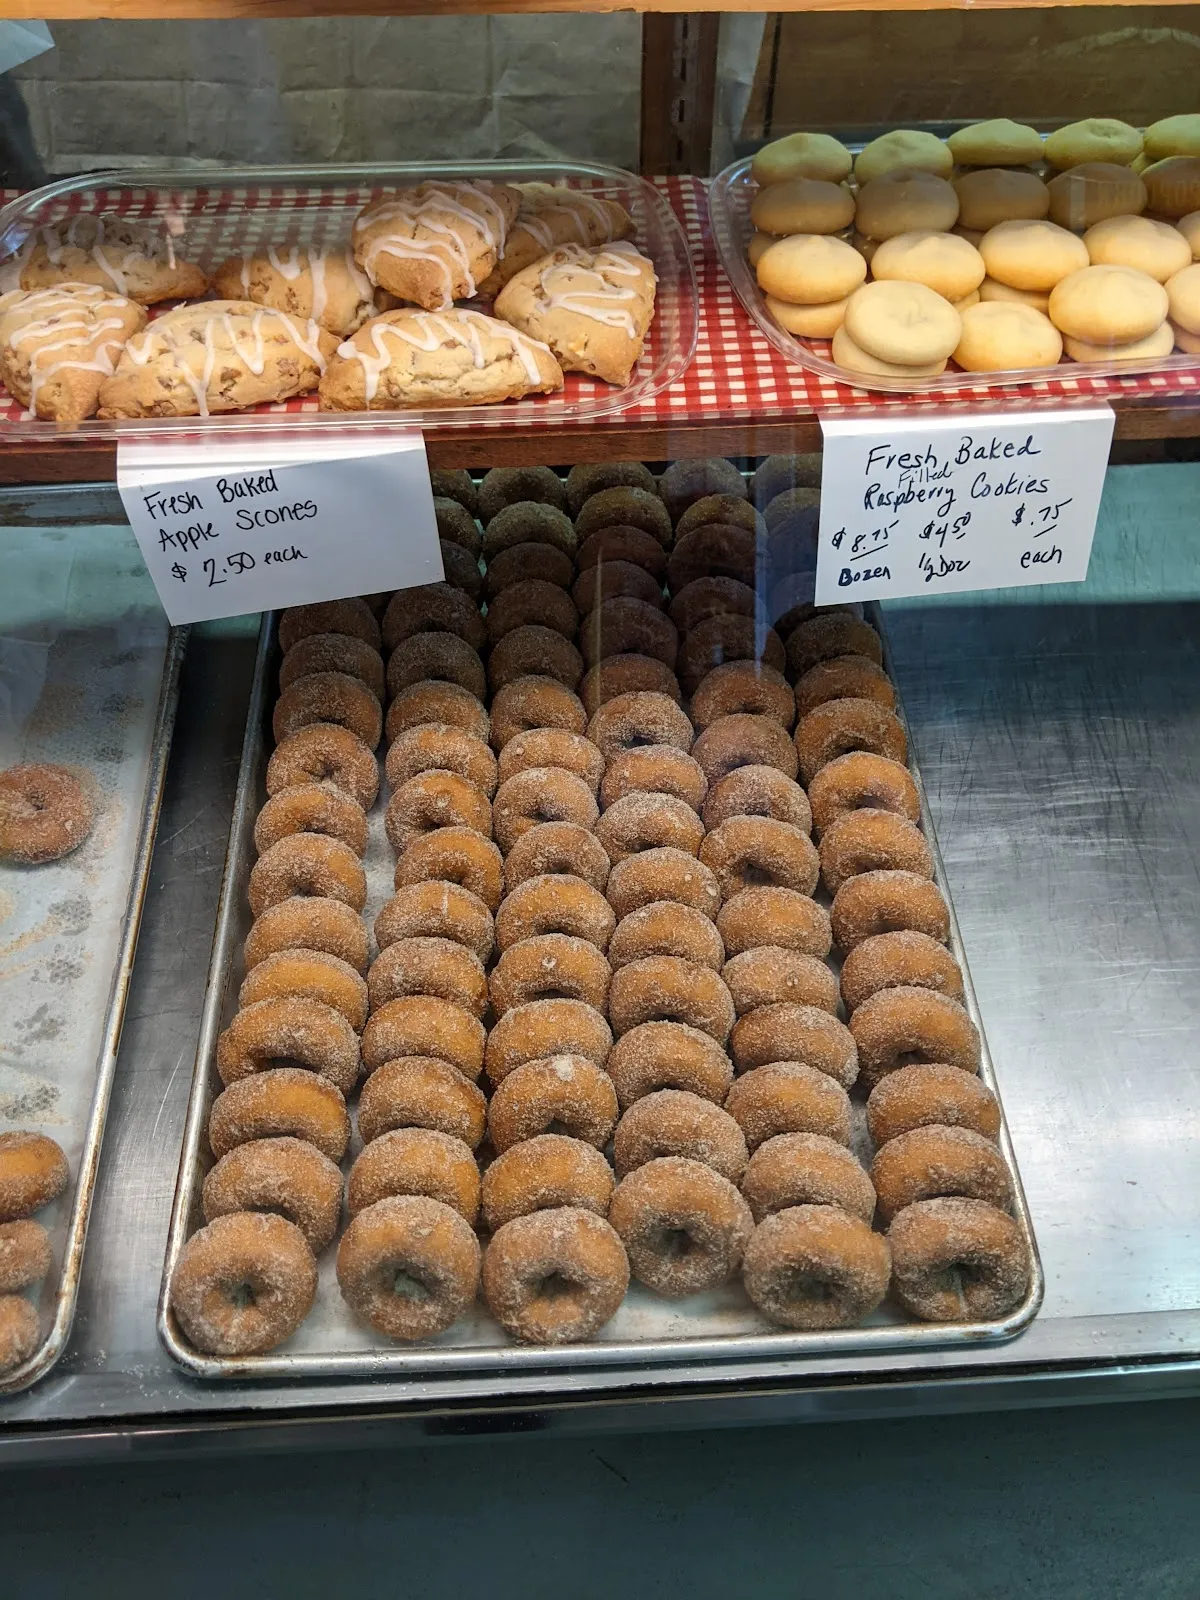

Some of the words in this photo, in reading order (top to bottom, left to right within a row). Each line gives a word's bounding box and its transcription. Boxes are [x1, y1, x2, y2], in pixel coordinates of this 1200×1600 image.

[865, 443, 938, 476] Fresh
[954, 434, 1042, 466] Baked
[898, 460, 954, 489] Filled
[142, 490, 204, 520] Fresh
[215, 468, 279, 504] Baked
[863, 485, 957, 518] Raspberry
[970, 470, 1051, 500] Cookies
[157, 521, 220, 553] Apple
[235, 499, 318, 531] Scones
[263, 545, 309, 566] each
[1020, 544, 1063, 569] each
